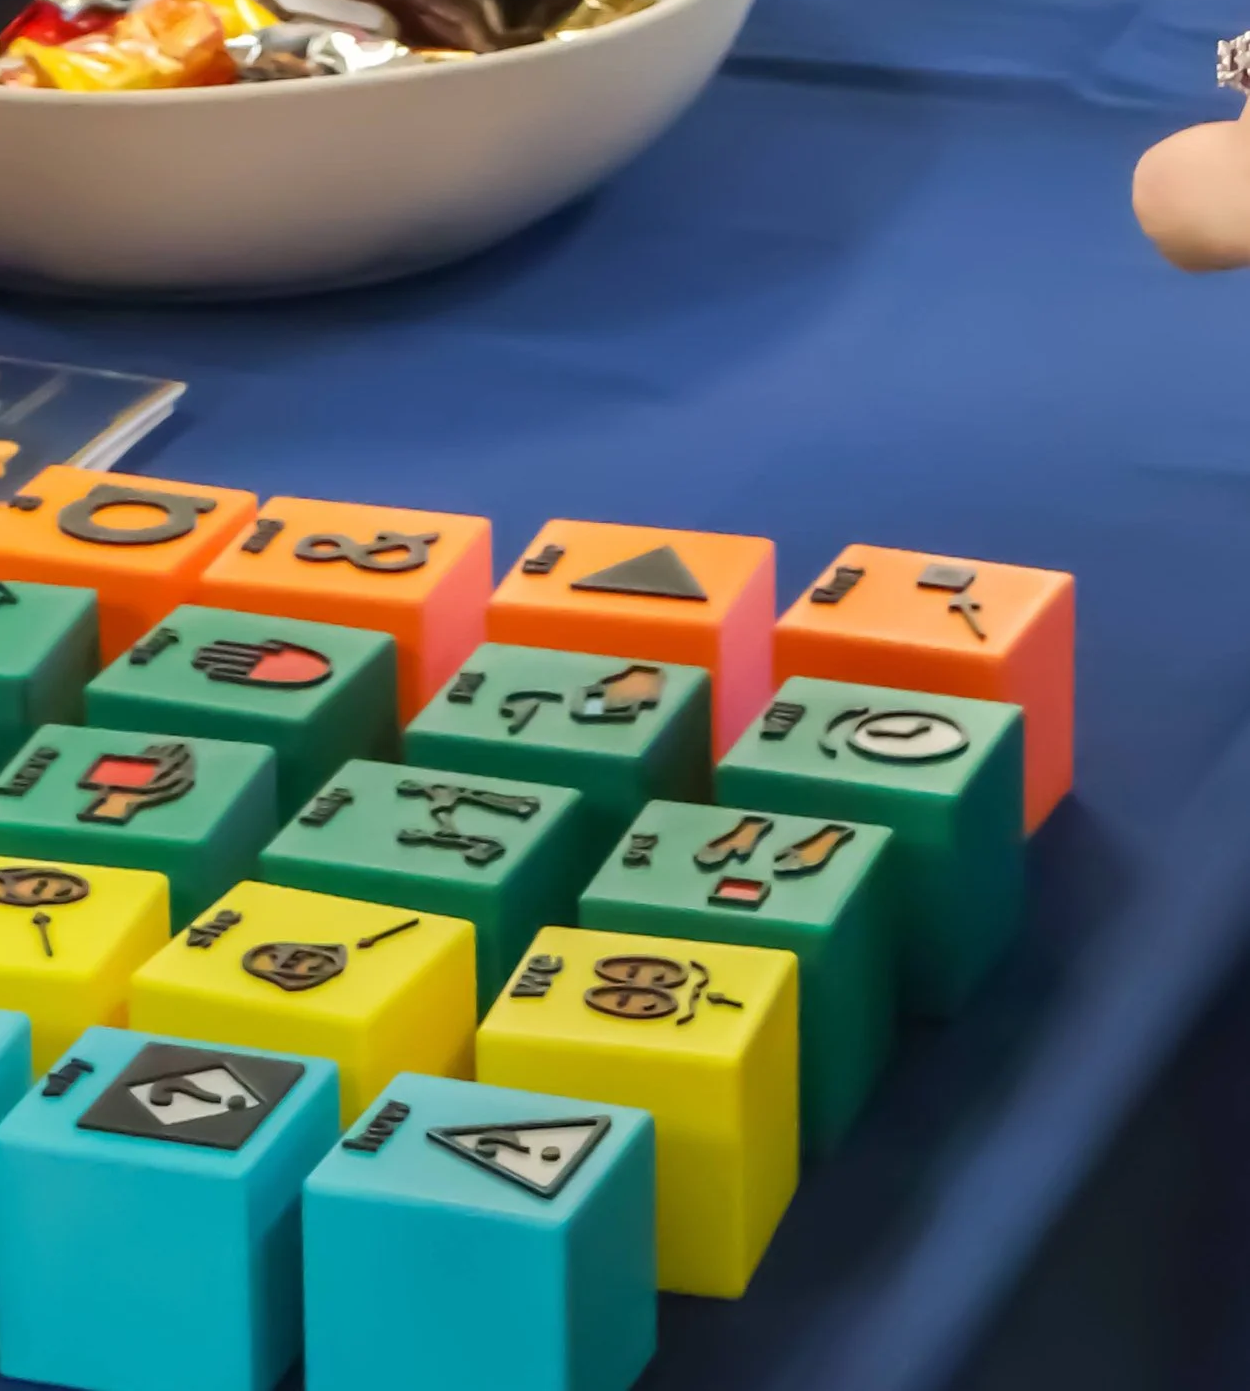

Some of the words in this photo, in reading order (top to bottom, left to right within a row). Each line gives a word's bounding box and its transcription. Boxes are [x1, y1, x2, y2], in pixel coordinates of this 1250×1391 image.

[186, 910, 242, 948] she
[510, 955, 563, 998] we
[342, 1100, 410, 1152] how
